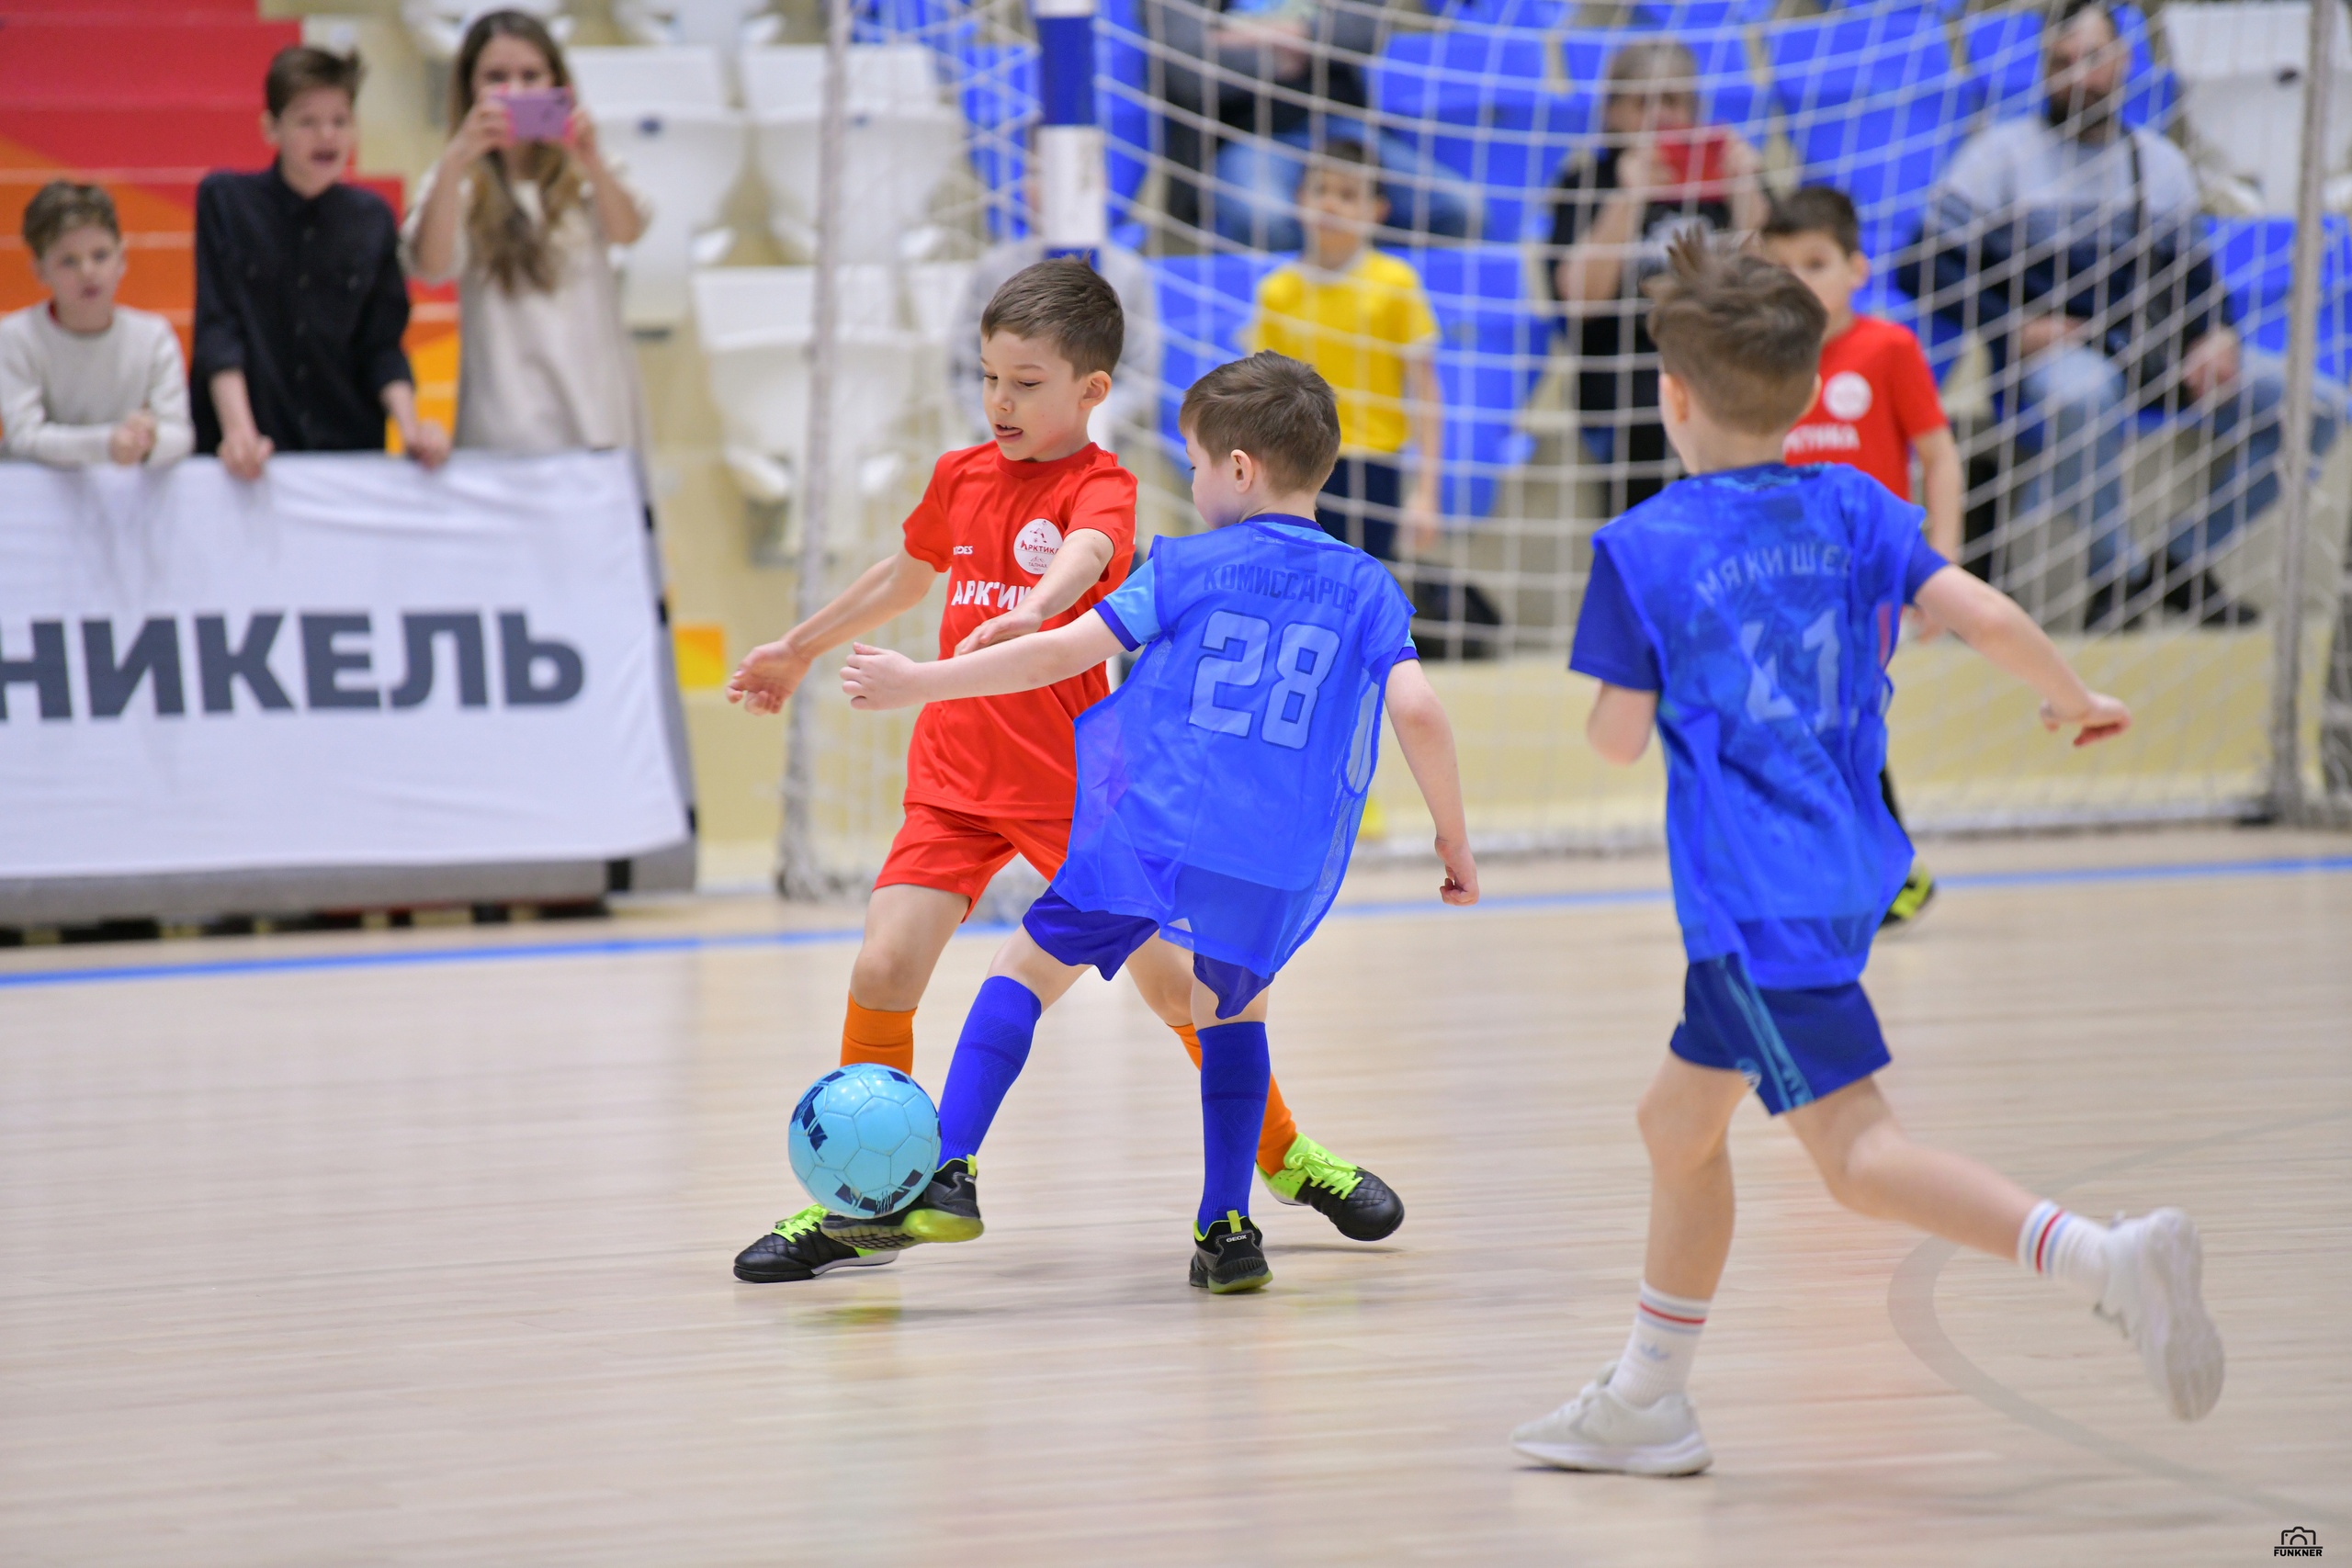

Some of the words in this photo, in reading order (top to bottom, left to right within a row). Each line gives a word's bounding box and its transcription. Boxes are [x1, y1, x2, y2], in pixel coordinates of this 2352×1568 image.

[951, 580, 1032, 611] АРКИК
[1204, 563, 1359, 615] КОМИССАРОВ
[0, 610, 585, 723] НИКЕЛЬ
[1188, 608, 1340, 750] 28
[1740, 608, 1860, 734] 41
[1226, 1235, 1248, 1243] GEOX
